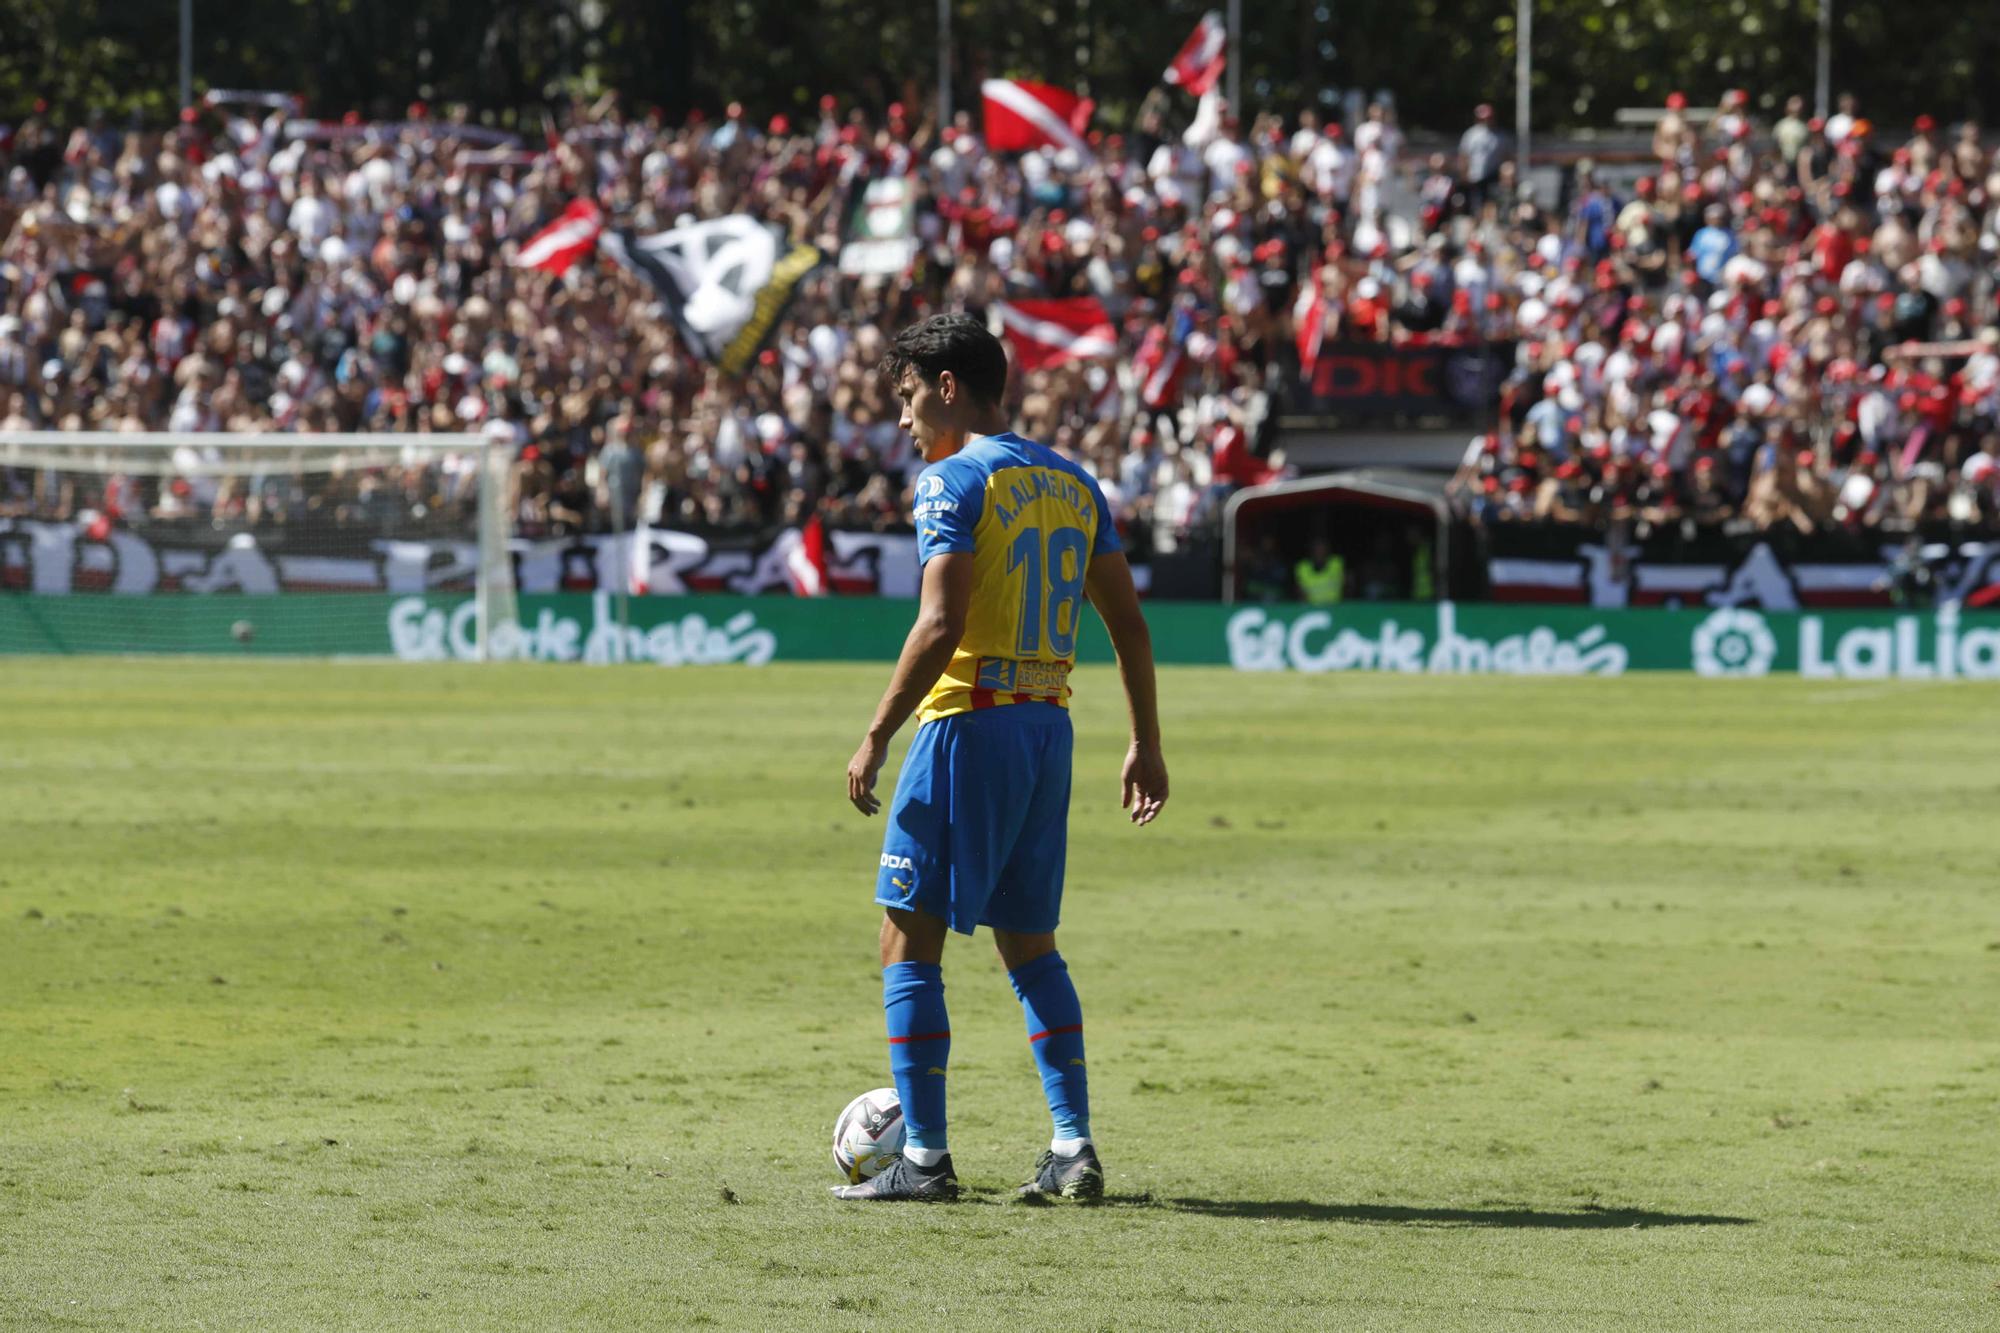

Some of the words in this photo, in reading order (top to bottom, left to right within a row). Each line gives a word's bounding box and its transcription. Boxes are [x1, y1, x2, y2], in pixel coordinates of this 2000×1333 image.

[995, 471, 1091, 529] A.ALMEIDA
[388, 598, 448, 661] El
[584, 588, 777, 666] Inglés
[1007, 527, 1088, 657] 18
[1226, 607, 1287, 671] El
[1288, 610, 1425, 673] Corte
[1427, 601, 1628, 675] Inglés
